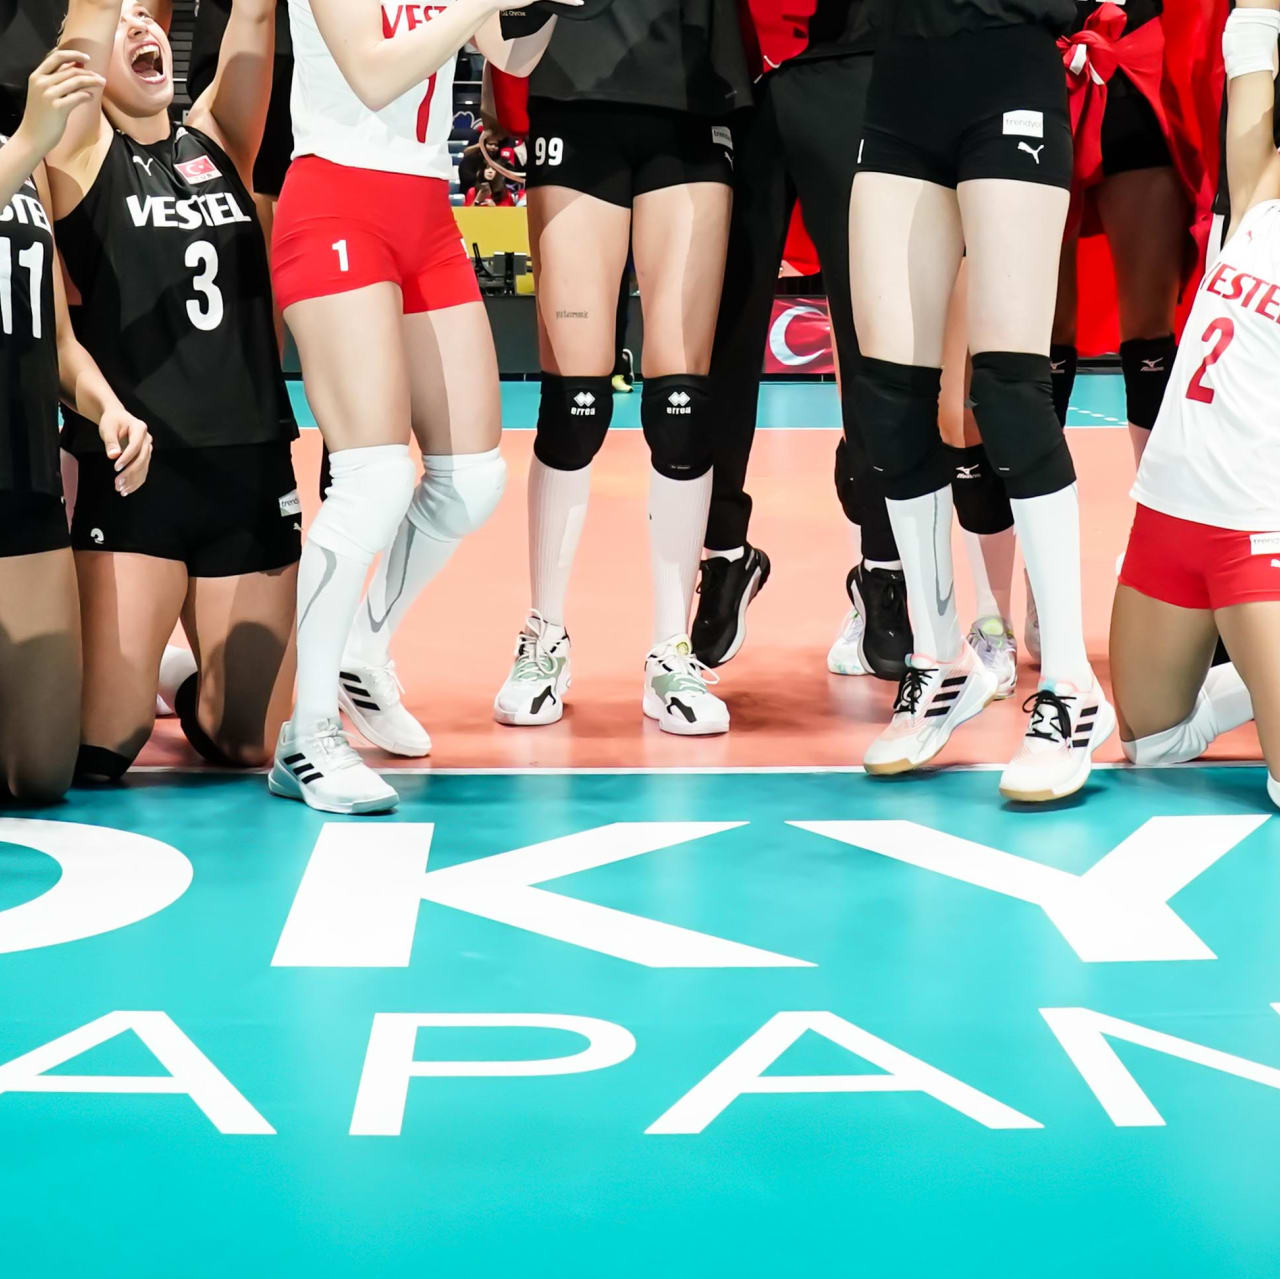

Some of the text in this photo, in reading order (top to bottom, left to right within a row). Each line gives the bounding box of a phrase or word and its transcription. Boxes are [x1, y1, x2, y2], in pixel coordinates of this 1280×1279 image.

[535, 136, 564, 166] 99
[125, 191, 253, 230] VESTEL
[331, 239, 349, 272] 1
[184, 240, 224, 331] 3
[1185, 316, 1235, 404] 2
